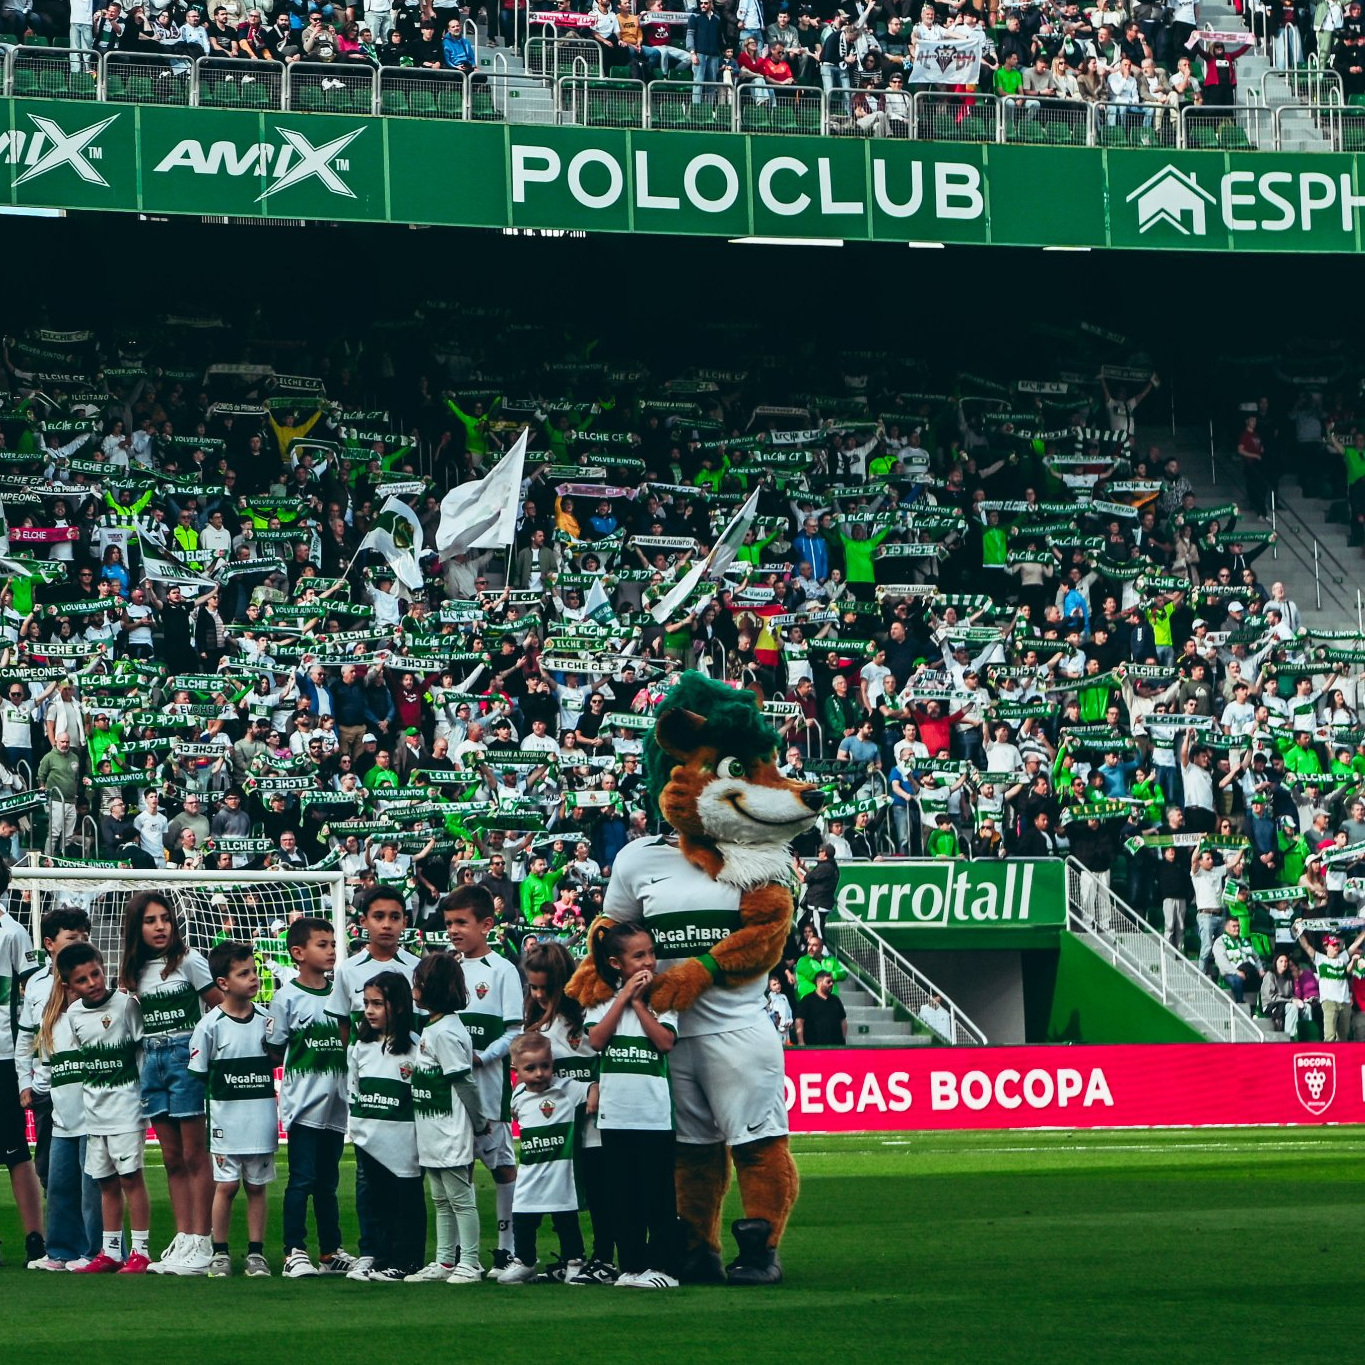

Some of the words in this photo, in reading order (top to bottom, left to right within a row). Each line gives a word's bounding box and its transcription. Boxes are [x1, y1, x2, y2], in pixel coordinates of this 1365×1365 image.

[512, 144, 740, 214] POLO
[758, 156, 984, 221] CLUB
[809, 640, 837, 648] VOLVER
[837, 640, 864, 648] JUNTOS
[931, 1068, 1113, 1111] BOCOPA
